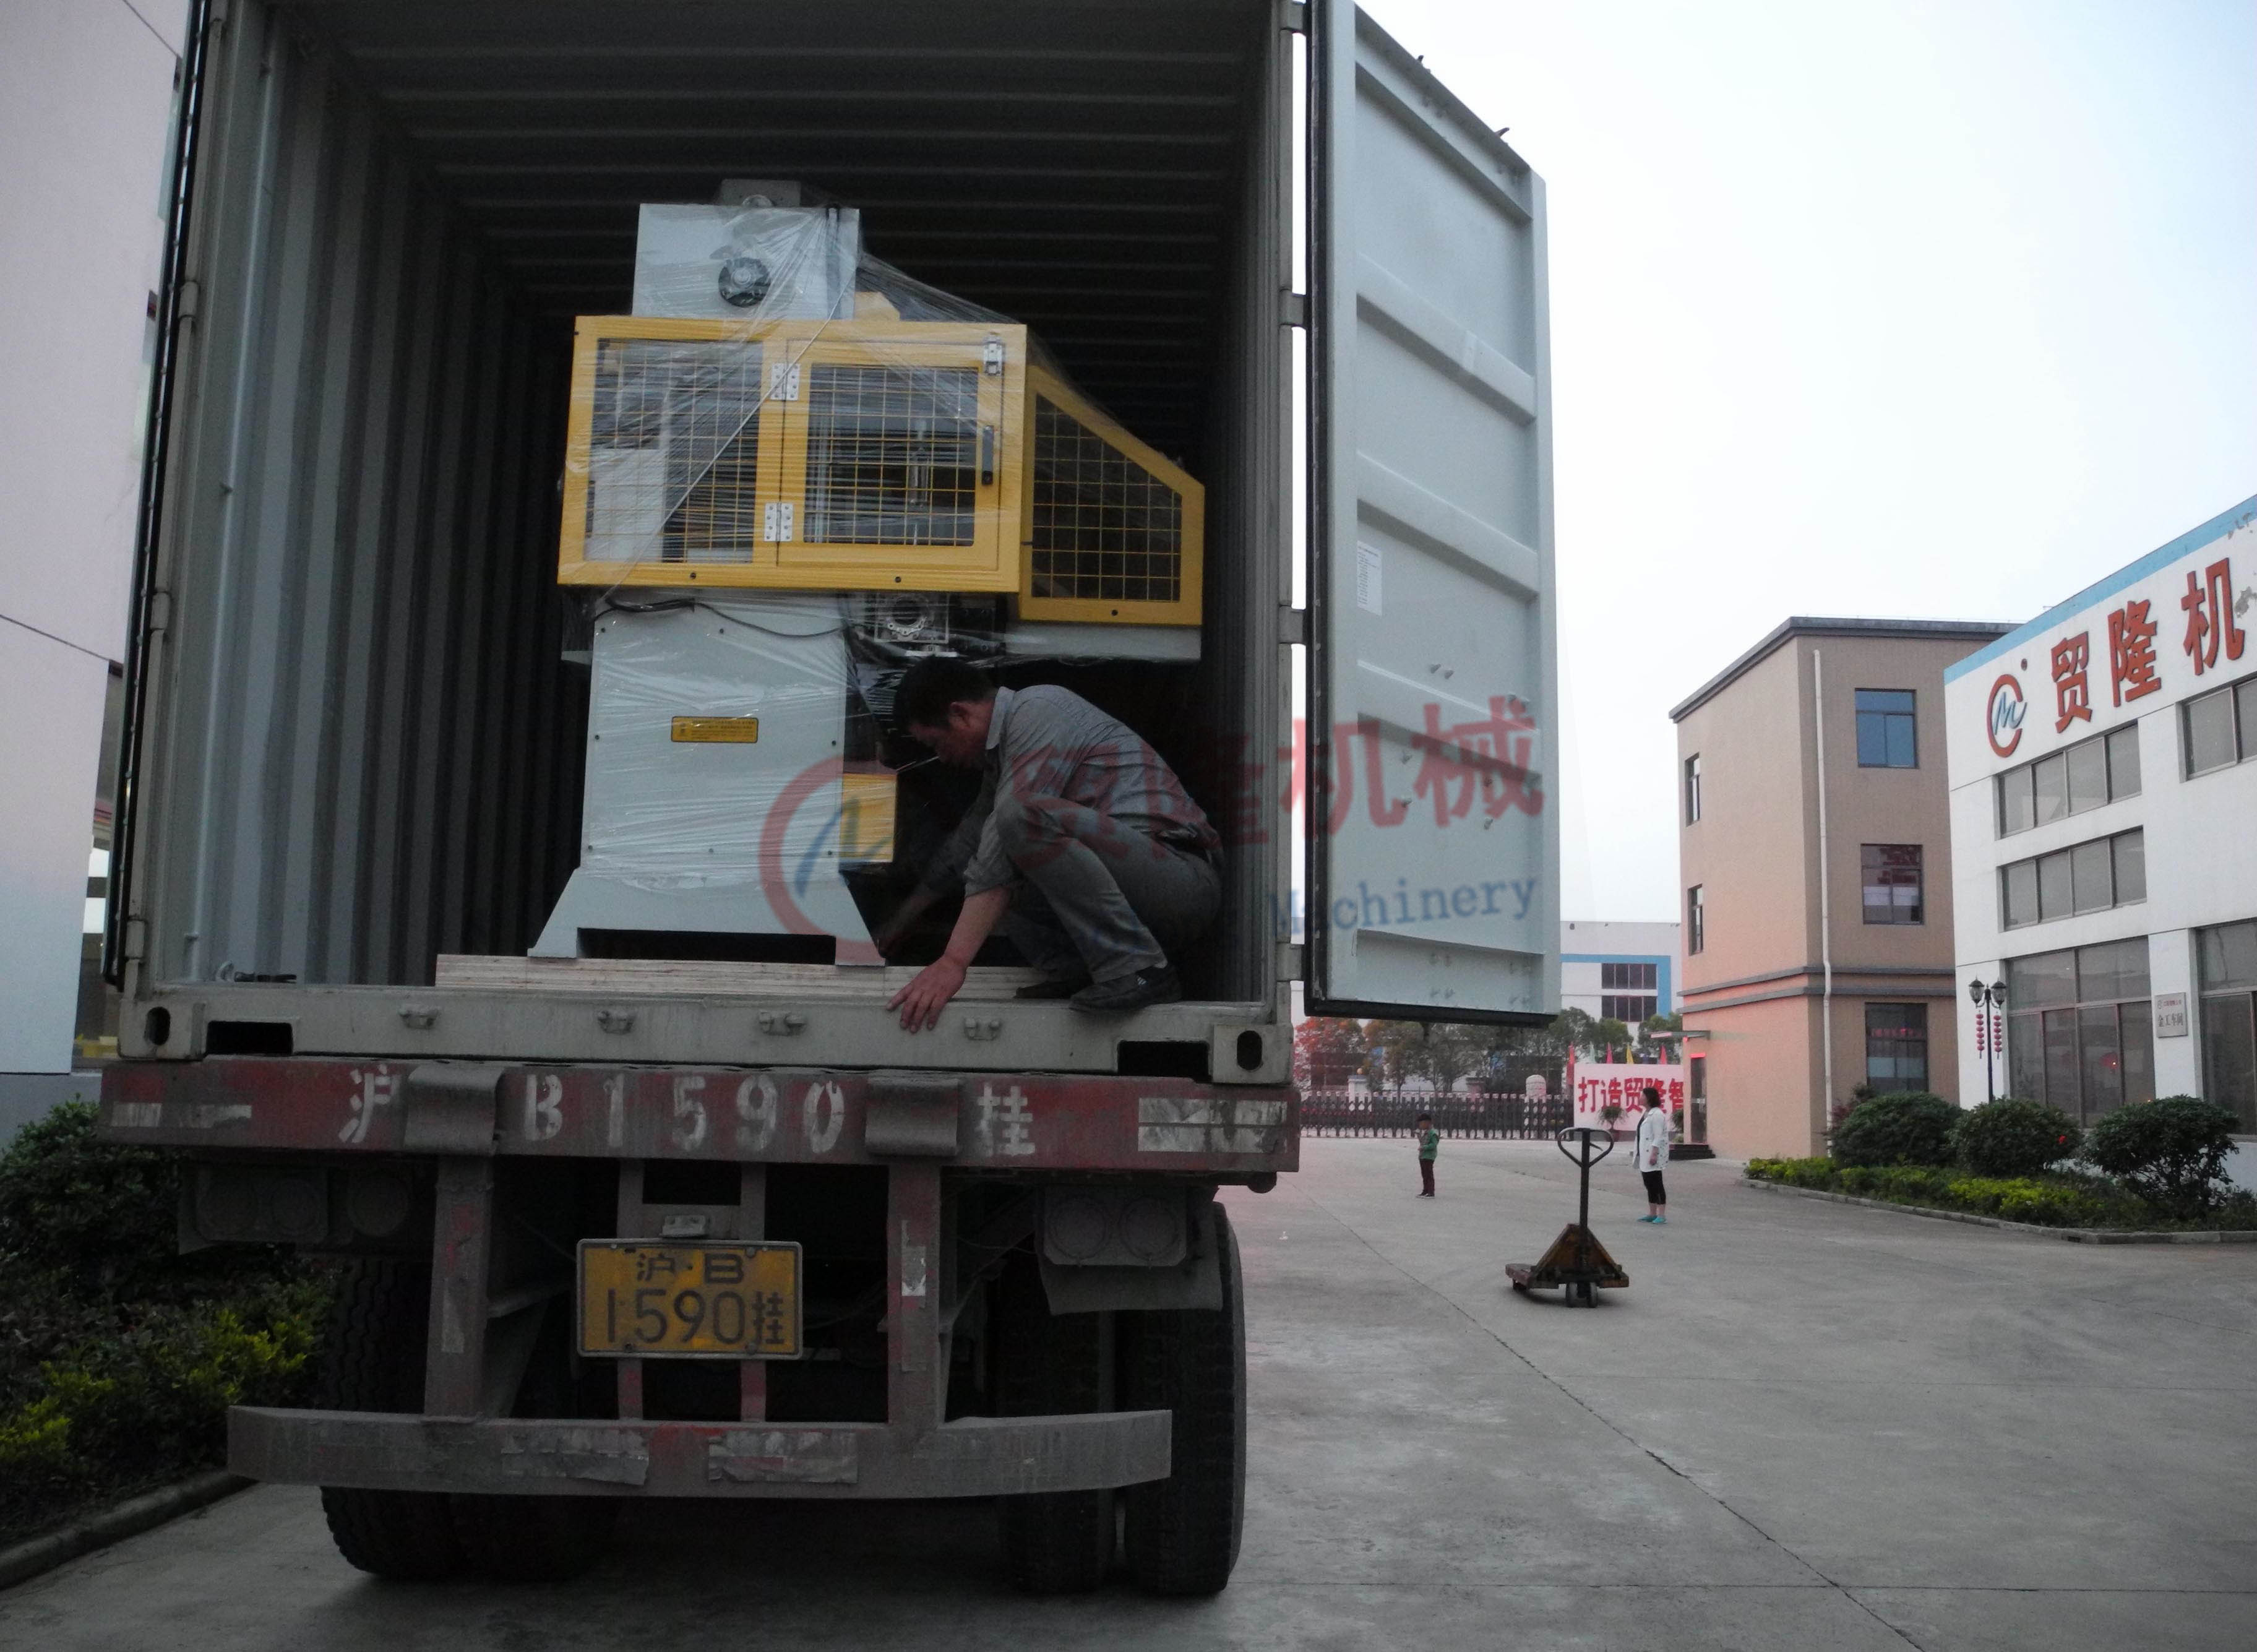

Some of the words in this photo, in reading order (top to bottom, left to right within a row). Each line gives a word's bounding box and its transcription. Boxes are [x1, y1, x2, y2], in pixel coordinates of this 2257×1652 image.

[2051, 557, 2245, 733] 贸隆机
[607, 1284, 785, 1345] 1590挂
